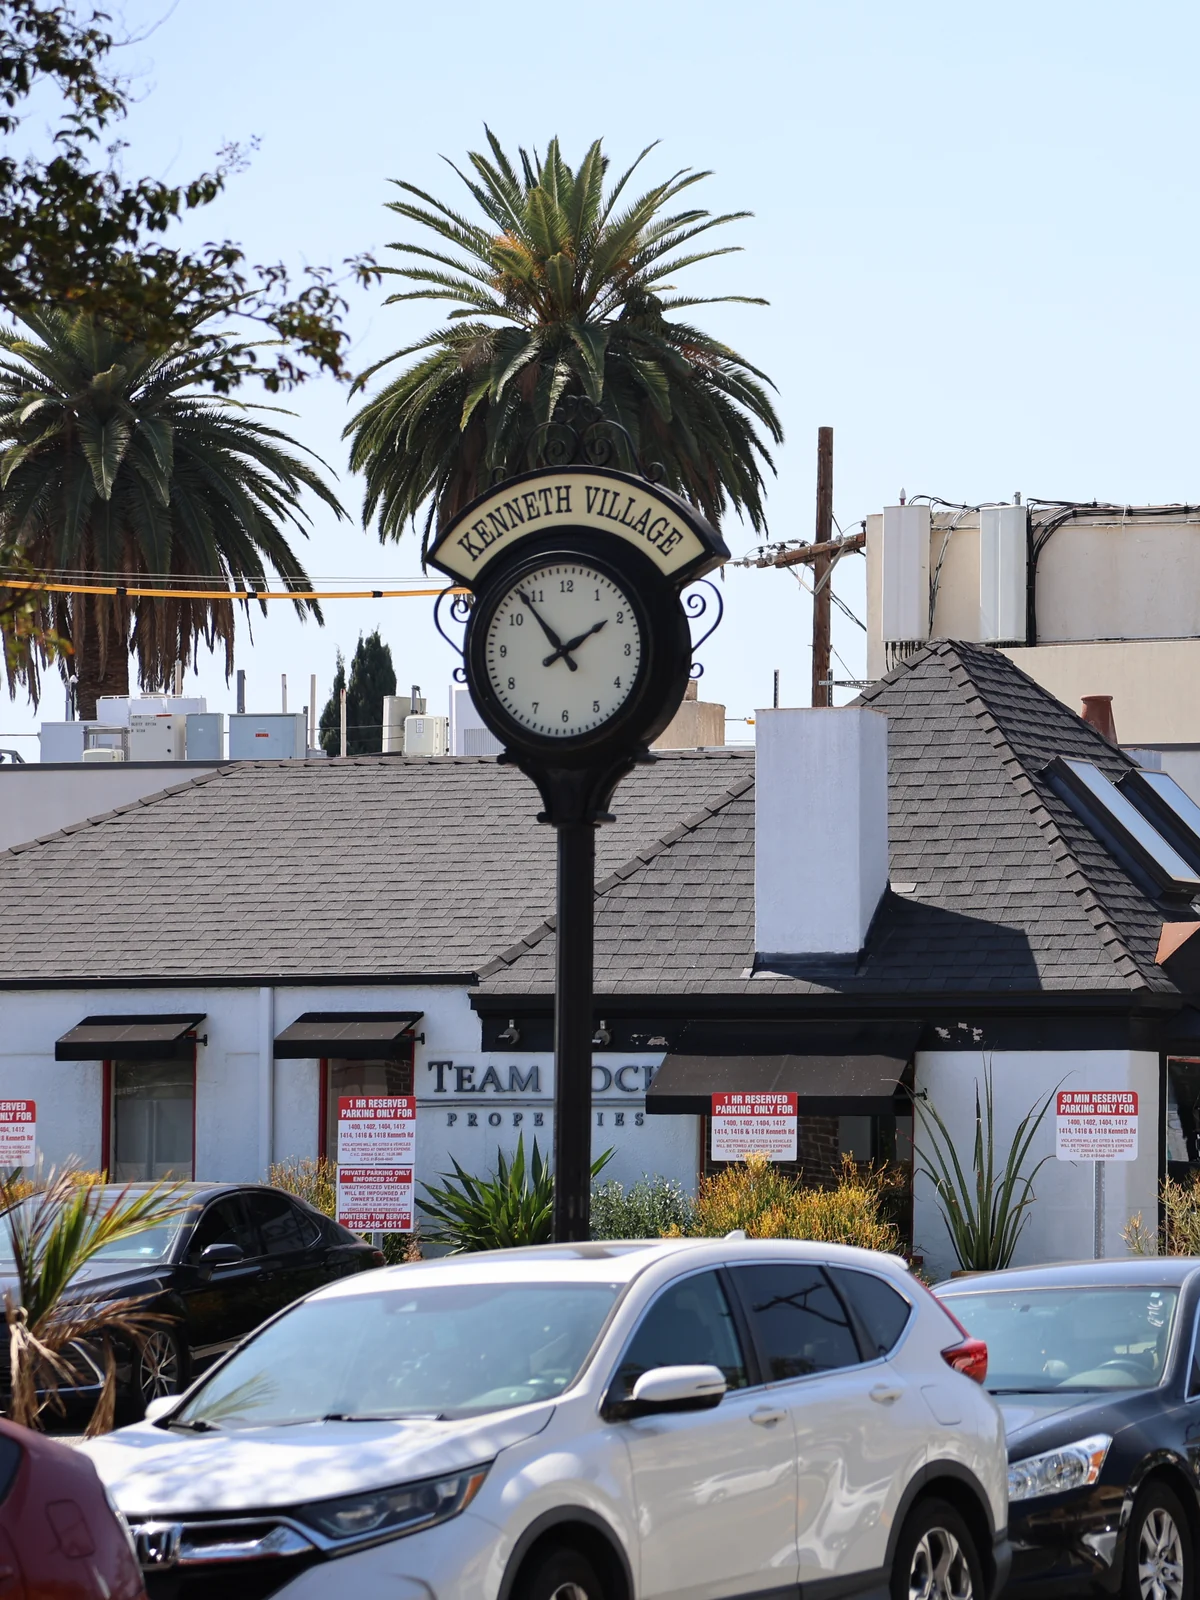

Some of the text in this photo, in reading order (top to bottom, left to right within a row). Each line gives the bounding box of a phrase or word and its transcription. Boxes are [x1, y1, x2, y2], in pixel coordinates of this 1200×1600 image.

[457, 484, 684, 562] KENNETH VILLAGE
[560, 581, 573, 592] 12
[532, 591, 544, 602] 11
[594, 590, 600, 601] 1
[510, 614, 523, 626] 10
[616, 612, 623, 624] 2
[500, 646, 507, 657] 9
[624, 644, 631, 656] 3
[508, 678, 515, 689] 8
[614, 677, 621, 688] 4
[532, 702, 539, 714] 7
[593, 701, 599, 712] 5
[562, 710, 568, 722] 6
[428, 1060, 541, 1092] TEAM
[349, 1099, 407, 1108] 1 HR RESERVED
[724, 1095, 788, 1104] 1 HR RESERVED
[1062, 1094, 1132, 1103] 30 MIN RESERVED
[342, 1109, 412, 1118] PARKING ONLY FOR
[716, 1105, 793, 1114] PARKING ONLY FOR
[1060, 1104, 1134, 1113] PARKING ONLY FOR
[16, 1112, 32, 1120] FOR
[447, 1112, 644, 1127] PROPEIES
